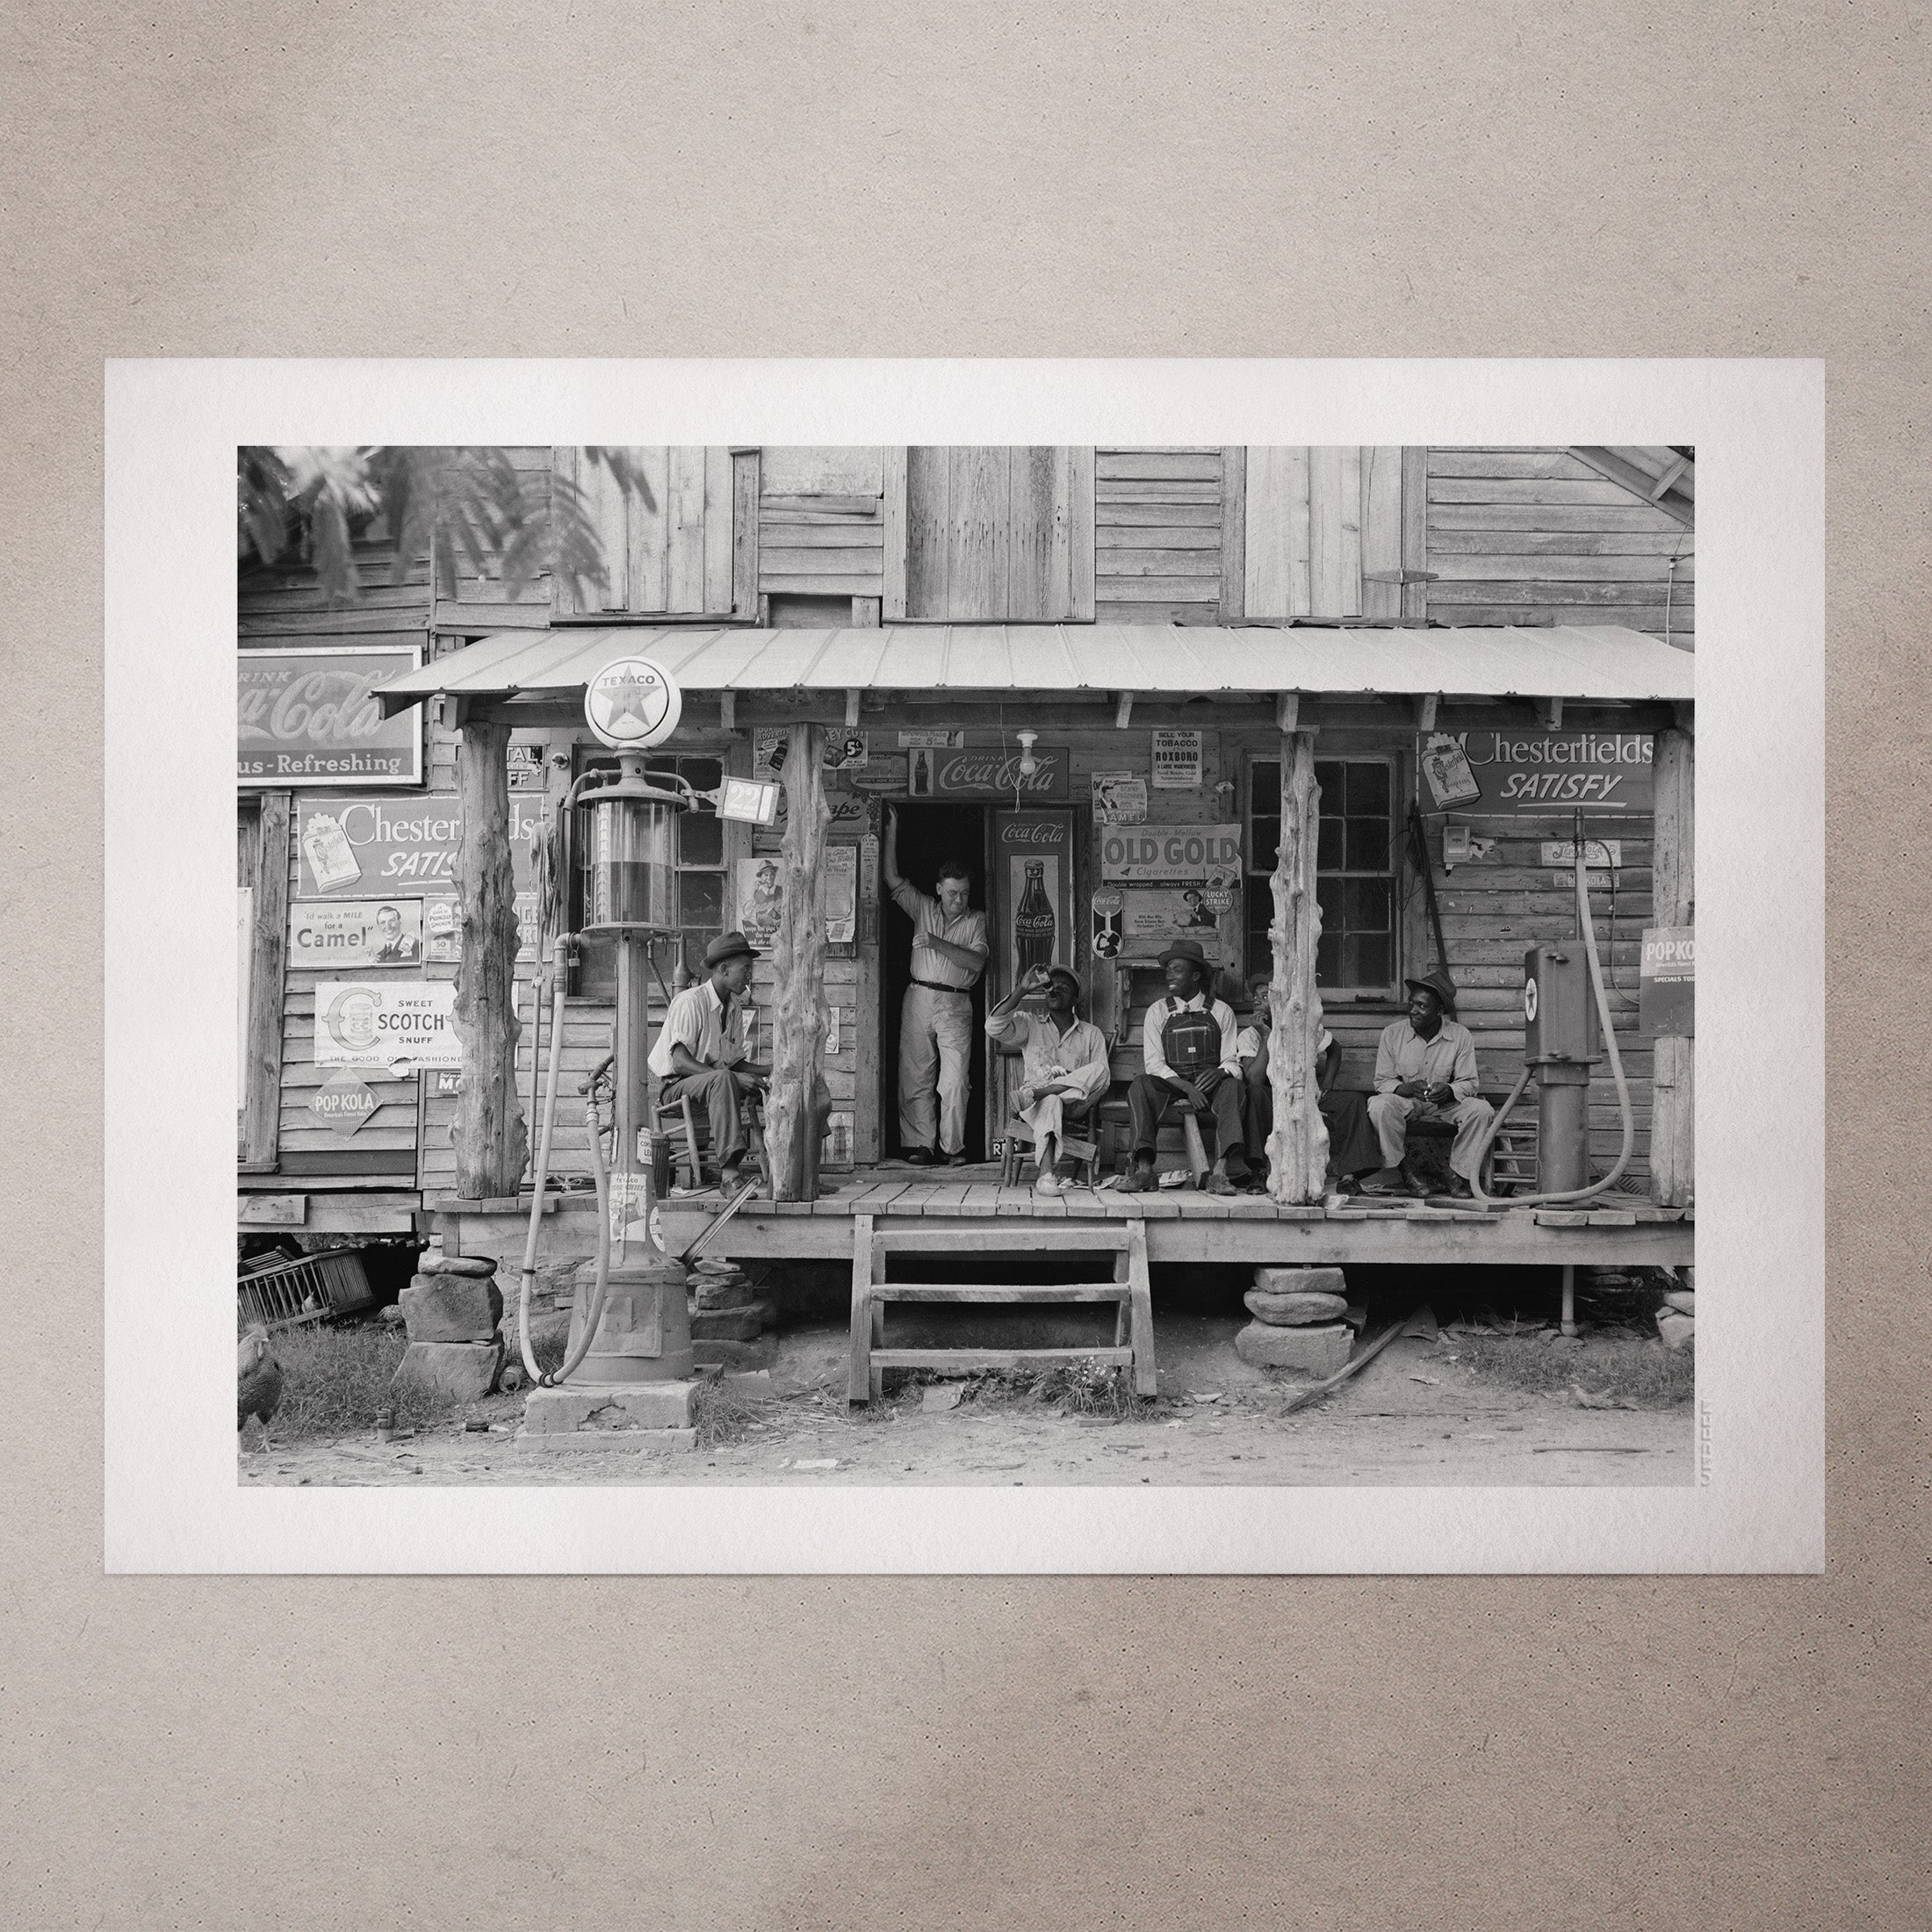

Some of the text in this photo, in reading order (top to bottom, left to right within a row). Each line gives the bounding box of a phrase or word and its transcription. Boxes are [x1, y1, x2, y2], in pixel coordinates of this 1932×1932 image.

[602, 674, 655, 687] TEXACO
[507, 746, 538, 762] TAL
[1156, 752, 1199, 762] ROXBORO
[1458, 732, 1654, 765] Chesterfields
[1500, 773, 1625, 800] SATISFY
[1104, 837, 1239, 865] OLD GOLD
[1136, 867, 1189, 877] Cigarettes
[1646, 940, 1695, 962] POP KO
[378, 1013, 444, 1031] SCOTCH
[315, 1092, 375, 1112] POP KOLA
